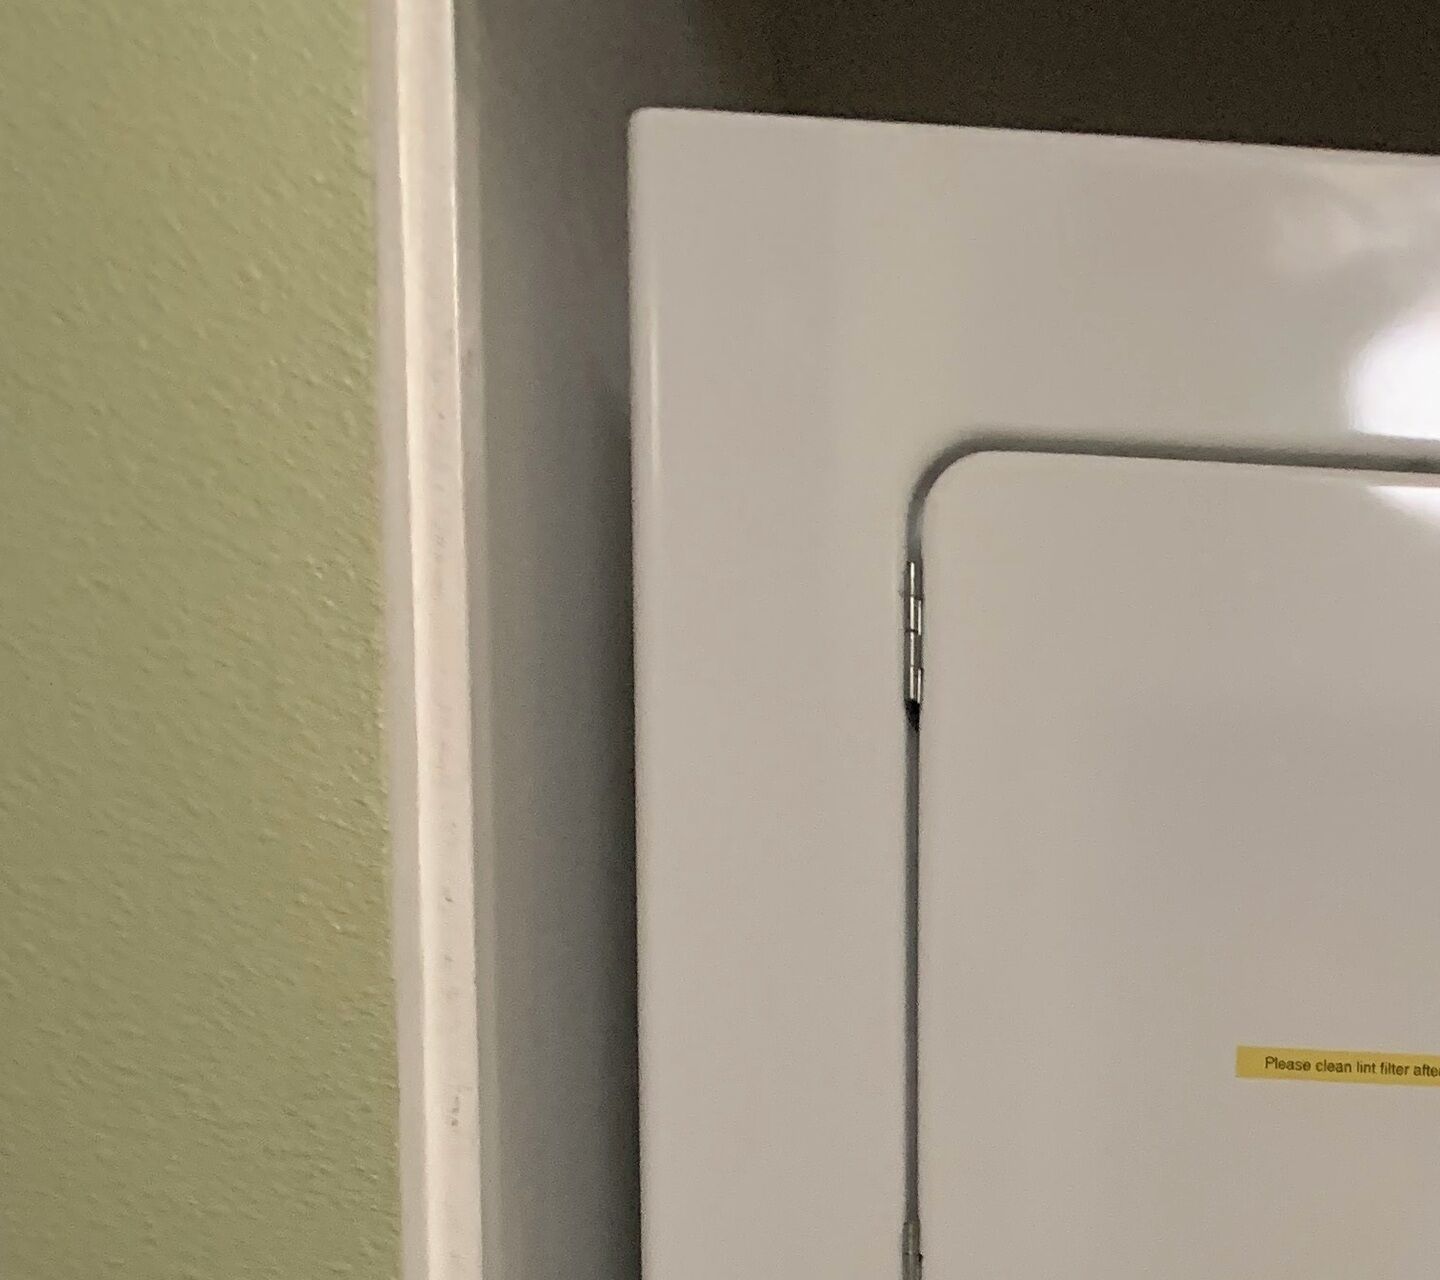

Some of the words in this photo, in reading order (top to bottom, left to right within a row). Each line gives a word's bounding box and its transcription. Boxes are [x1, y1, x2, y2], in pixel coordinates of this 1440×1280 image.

[1264, 1056, 1312, 1073] Please
[1315, 1059, 1352, 1073] clean
[1356, 1061, 1376, 1074] lint
[1380, 1062, 1410, 1076] filter
